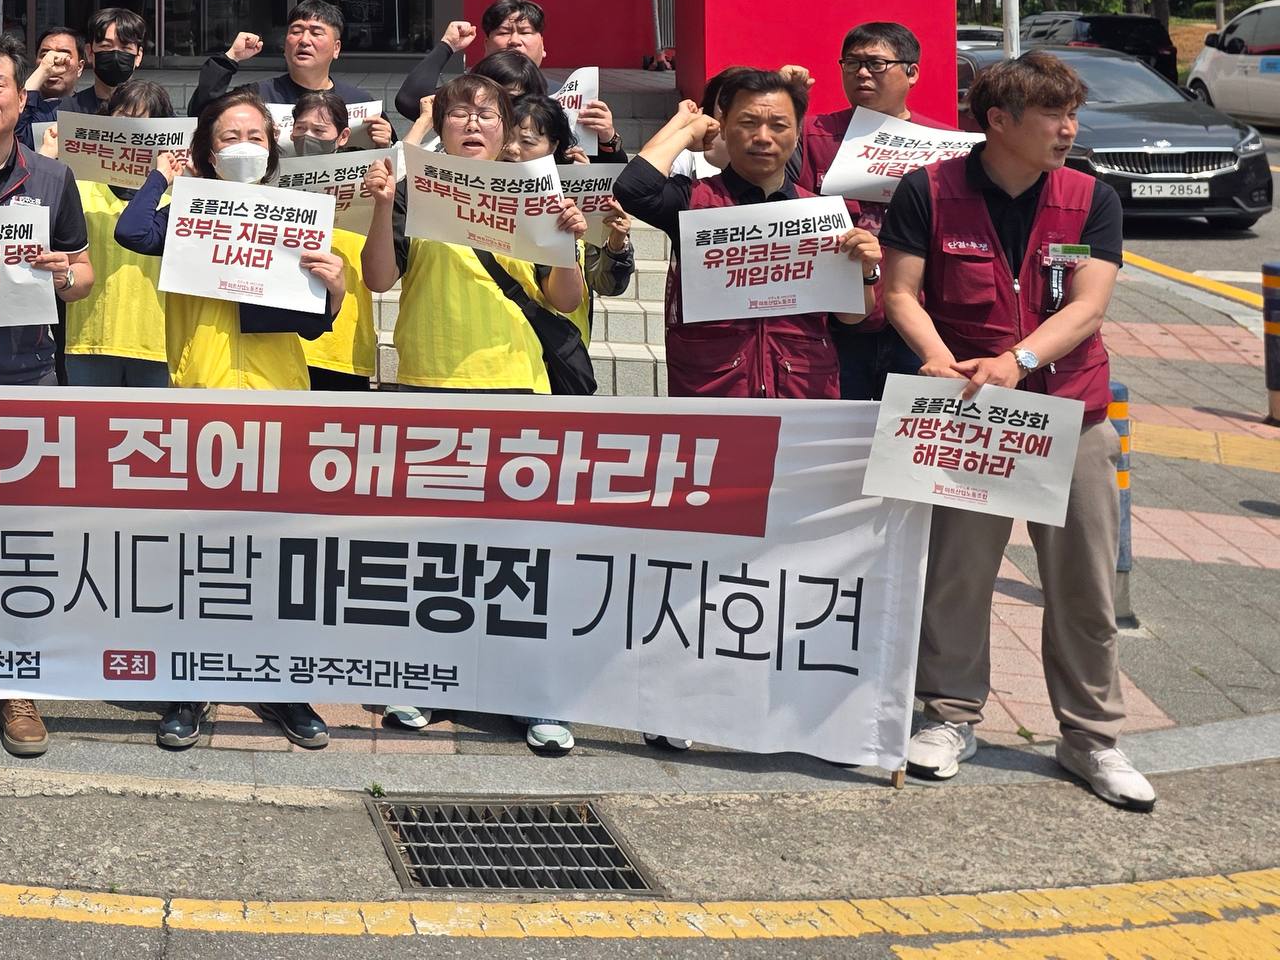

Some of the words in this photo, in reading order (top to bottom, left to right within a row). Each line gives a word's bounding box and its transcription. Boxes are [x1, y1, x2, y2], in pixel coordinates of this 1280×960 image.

[75, 127, 128, 144] 홈플러스
[131, 132, 184, 146] 정상화에
[873, 131, 933, 149] 홈플러스
[64, 140, 115, 158] 정부는
[120, 147, 153, 164] 지금
[857, 145, 936, 161] 지방선거
[101, 160, 151, 177] 나서라
[278, 171, 330, 188] 홈플러스
[424, 165, 485, 190] 홈플러스
[490, 174, 553, 193] 정상화에
[414, 176, 471, 205] 정부는
[477, 193, 519, 216] 지금
[560, 178, 612, 193] 정상화에
[1139, 185, 1162, 195] 21구
[1169, 185, 1201, 195] 2854
[189, 198, 249, 218] 홈플러스
[253, 203, 317, 225] 정상화에
[456, 206, 516, 234] 나서라
[175, 217, 232, 241] 정부는
[236, 222, 278, 245] 지금
[283, 227, 325, 250] 당장
[695, 224, 763, 247] 홈플러스
[767, 213, 847, 238] 기업회생에
[4, 244, 44, 265] 당장
[211, 244, 273, 270] 나서라
[703, 242, 791, 269] 유암코는
[797, 235, 842, 257] 즉각
[725, 261, 814, 289] 개입하라
[911, 397, 981, 420] 홈플러스
[988, 405, 1049, 430] 정상화
[894, 417, 993, 449] 지방선거
[999, 429, 1053, 458] 전에
[108, 417, 279, 495] 전에
[309, 422, 720, 508] 해결하라!
[912, 443, 1016, 478] 해결하라
[279, 535, 551, 640] 마트광전
[573, 551, 863, 677] 기자회견
[109, 652, 151, 676] 주최
[170, 651, 280, 684] 마트노조
[288, 654, 459, 692] 광주전라본부
